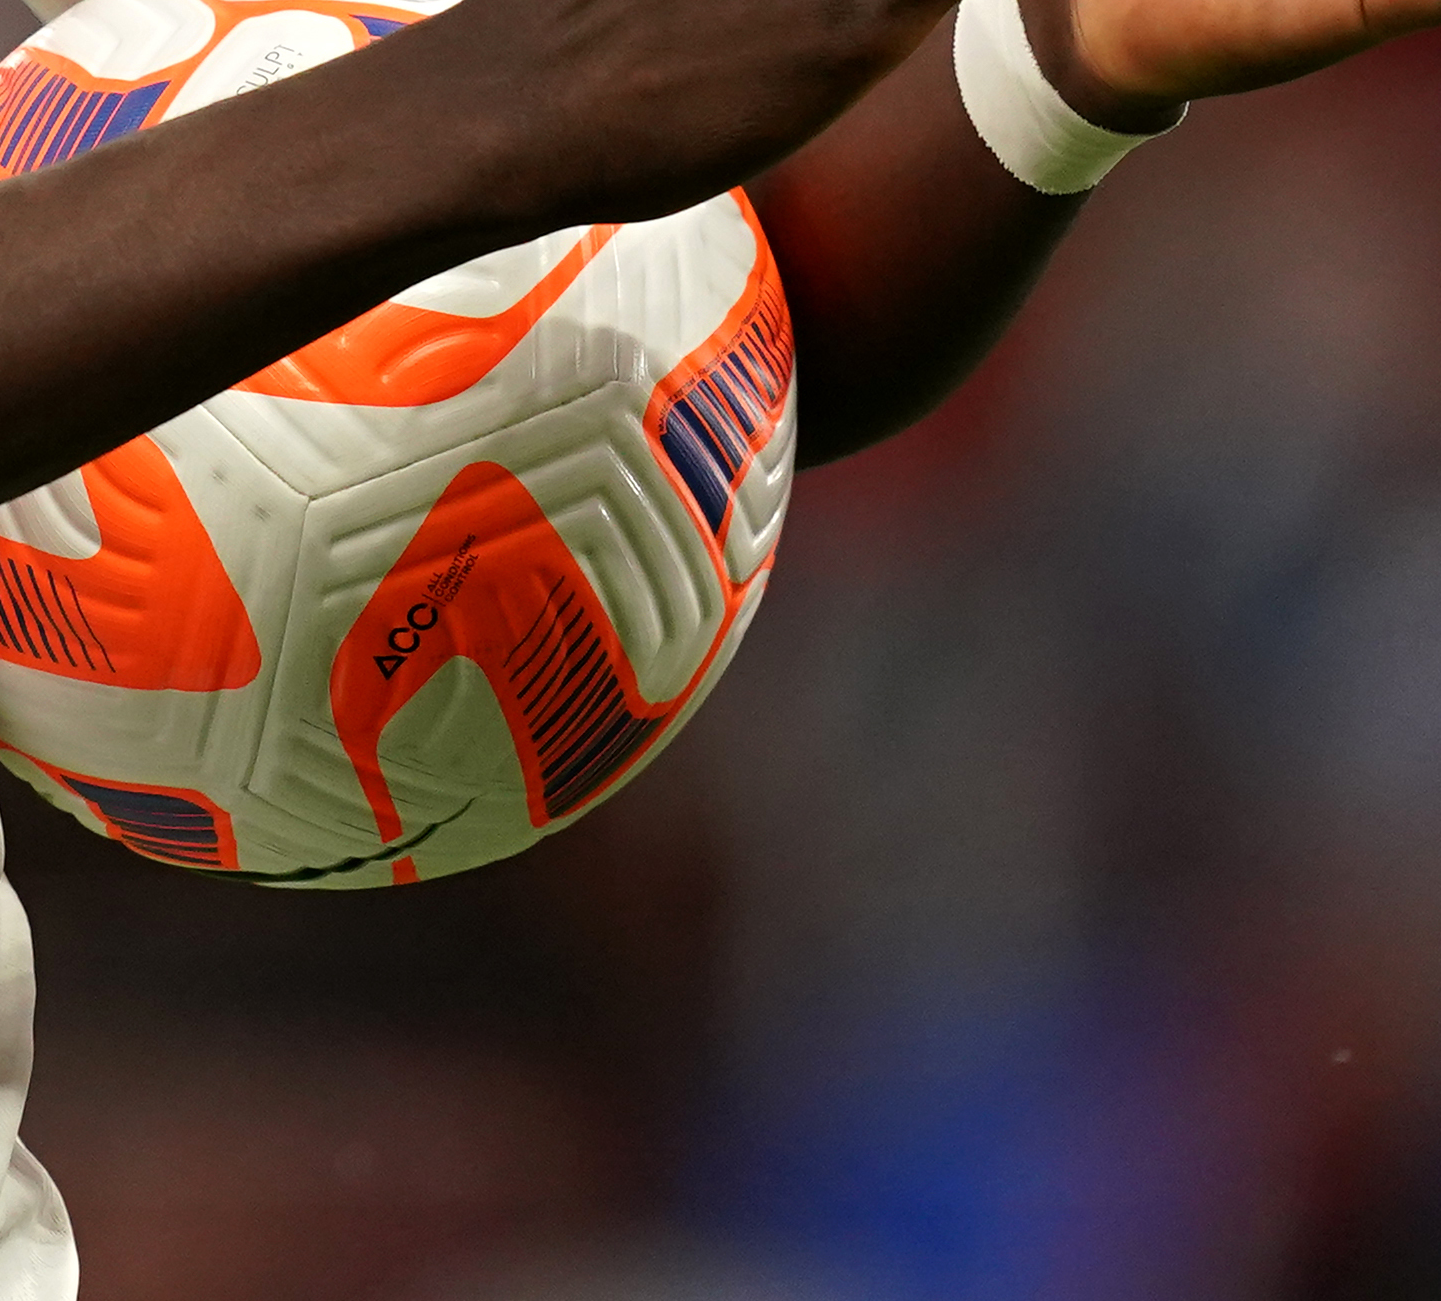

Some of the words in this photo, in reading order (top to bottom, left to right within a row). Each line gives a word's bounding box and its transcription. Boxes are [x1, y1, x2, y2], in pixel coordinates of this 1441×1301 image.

[427, 572, 443, 593] ALL
[435, 534, 477, 597] CONDITIONS
[444, 554, 479, 602] CONTROL
[373, 602, 438, 680] ACC
